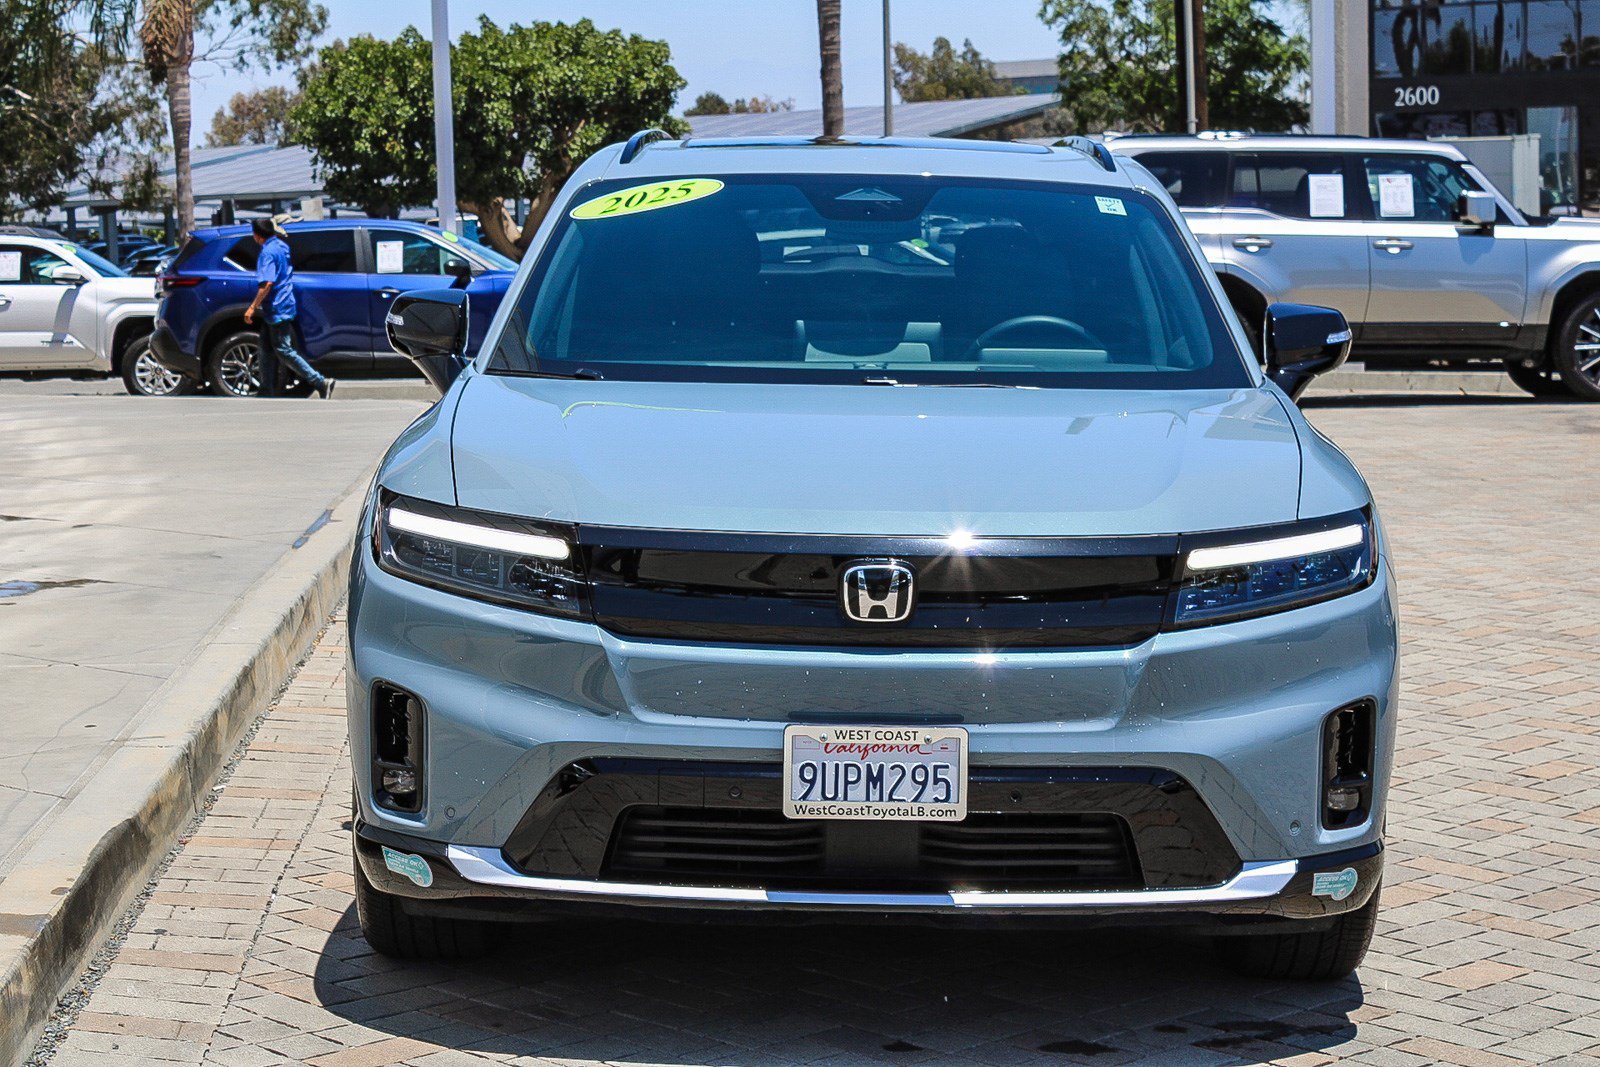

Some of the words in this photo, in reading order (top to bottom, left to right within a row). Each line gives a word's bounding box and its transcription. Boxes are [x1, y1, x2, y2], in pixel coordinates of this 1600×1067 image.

[1394, 85, 1440, 107] 2600
[600, 182, 697, 214] 2025
[834, 729, 871, 741] WEST
[874, 730, 919, 741] COAST
[798, 762, 952, 803] 9UPM295
[794, 804, 957, 818] WestCoastToyotaLB.com
